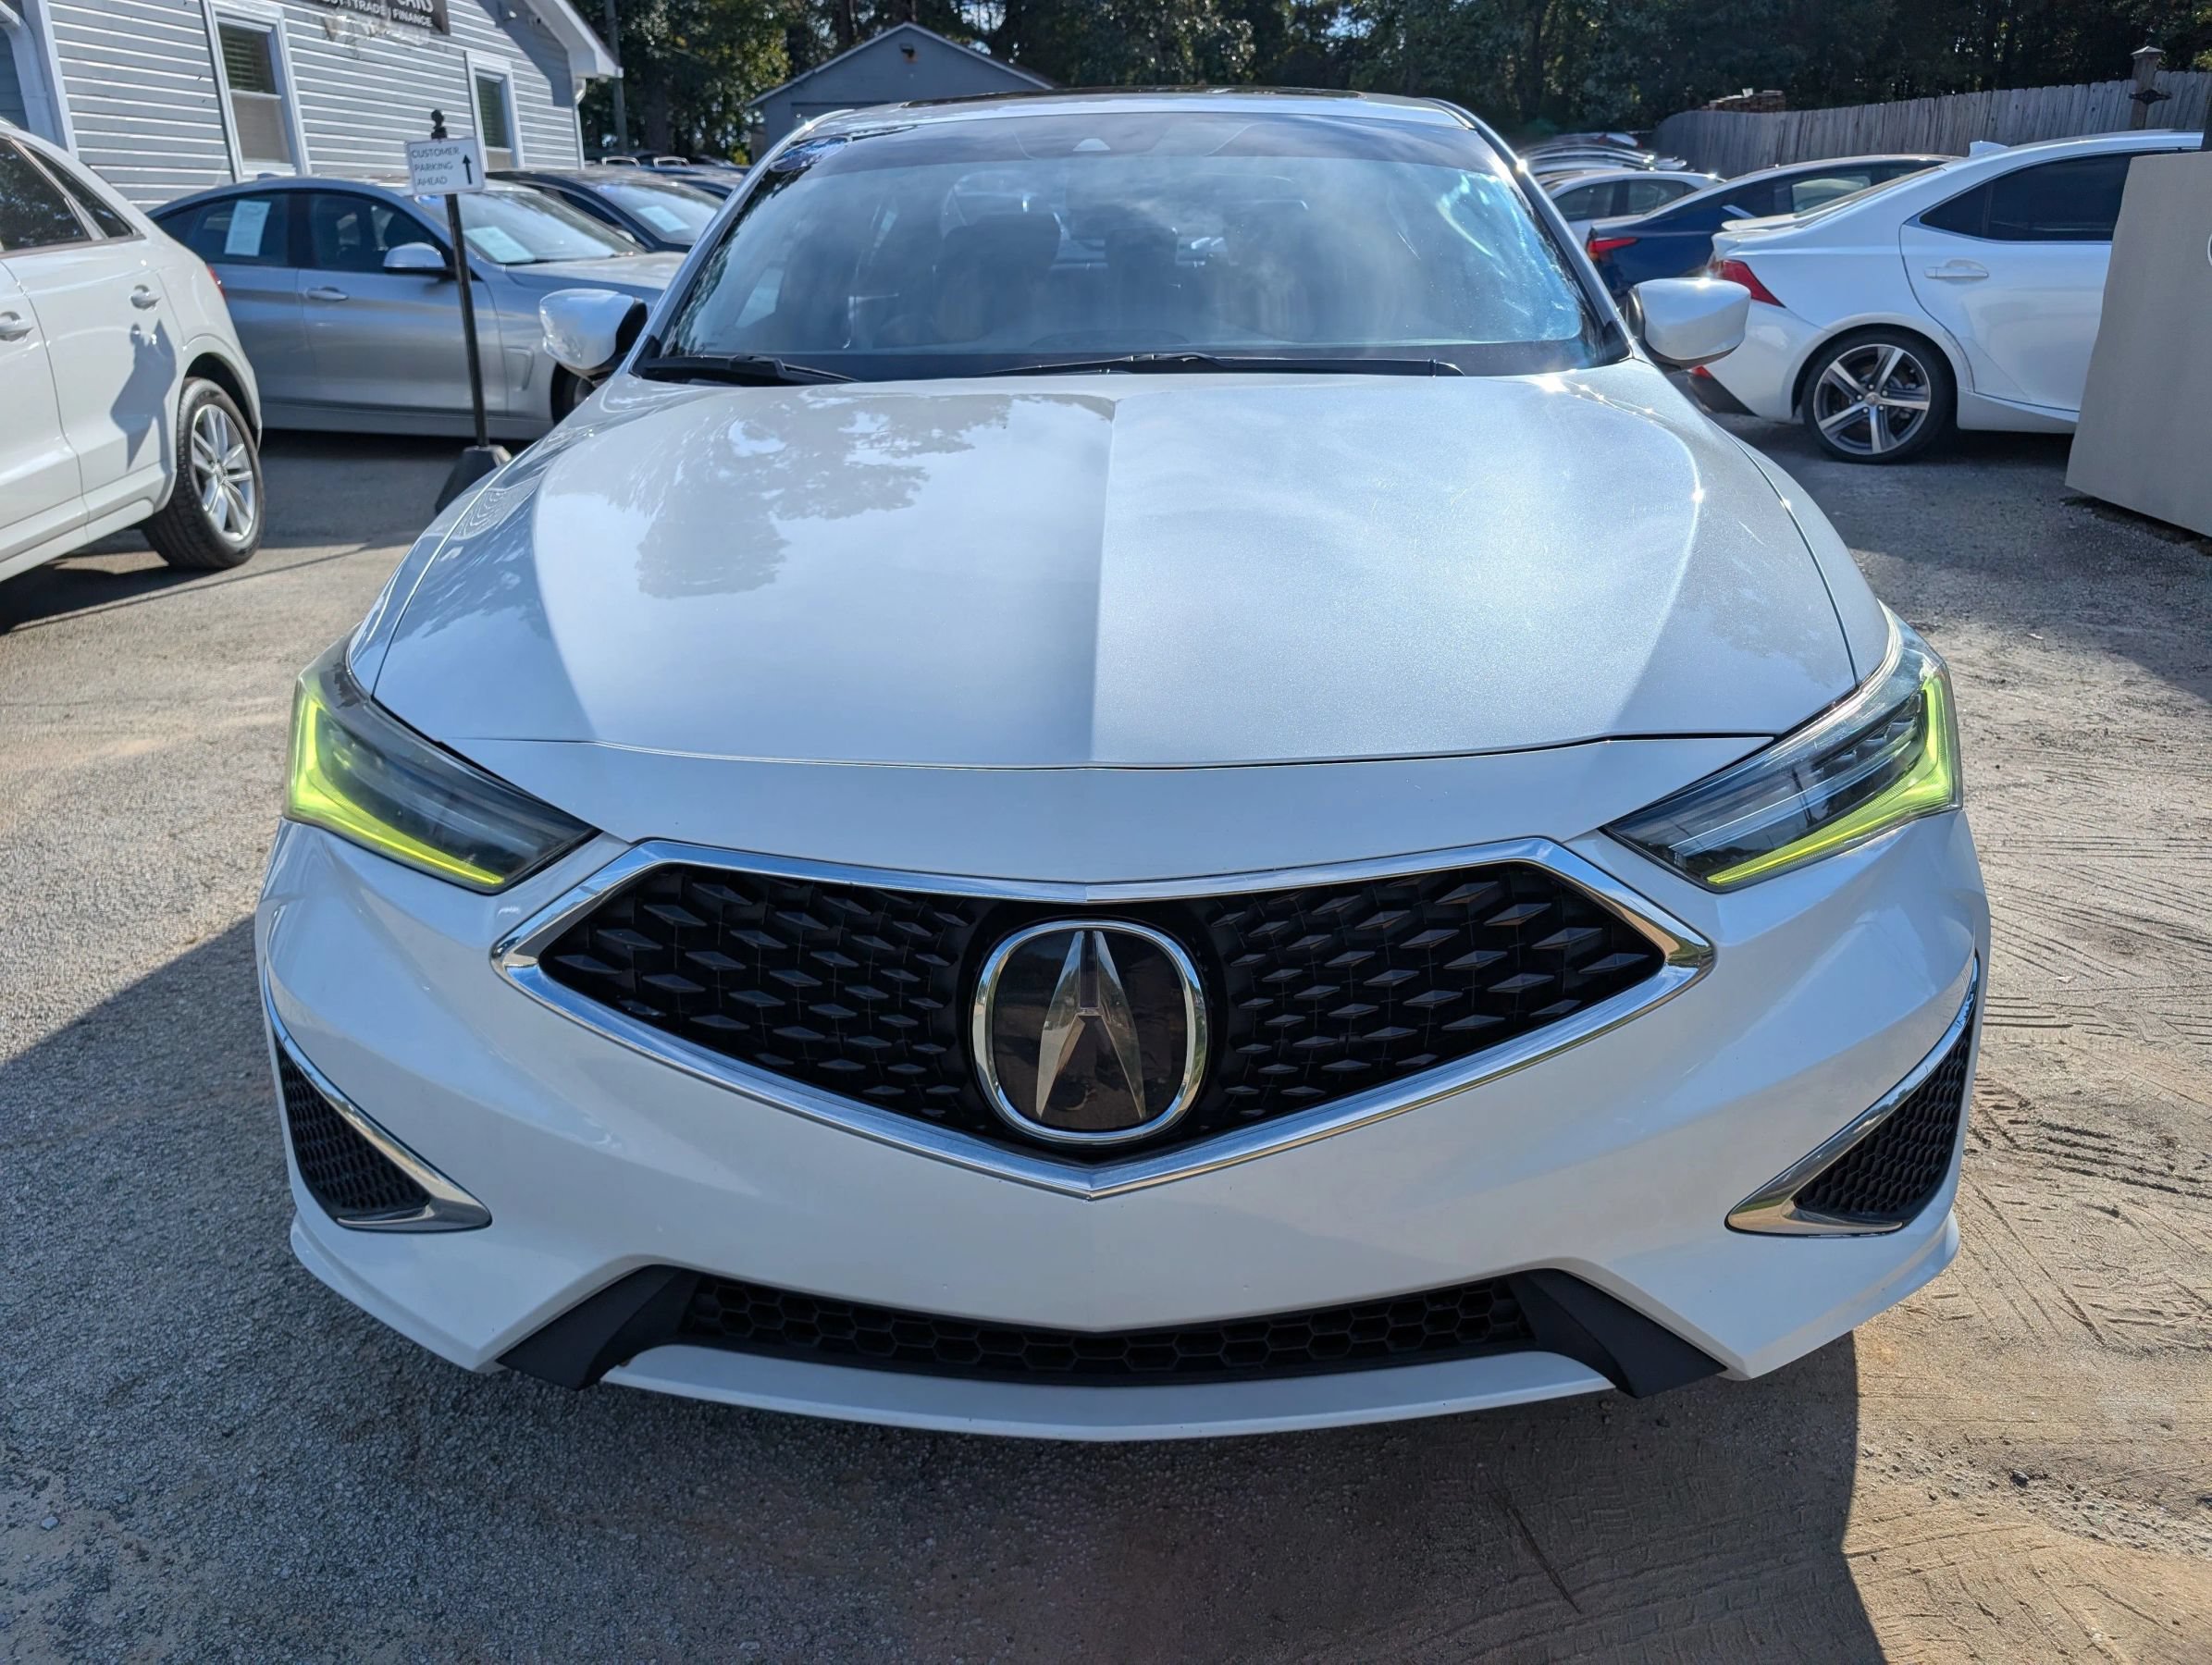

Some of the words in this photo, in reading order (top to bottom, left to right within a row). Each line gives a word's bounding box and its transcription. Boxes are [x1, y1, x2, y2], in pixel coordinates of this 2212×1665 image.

[353, 0, 385, 16] TRADE
[392, 7, 433, 27] FINANCE
[412, 147, 459, 158] CUSTOMER
[414, 162, 453, 171] PARKING
[417, 177, 448, 186] AHEAD
